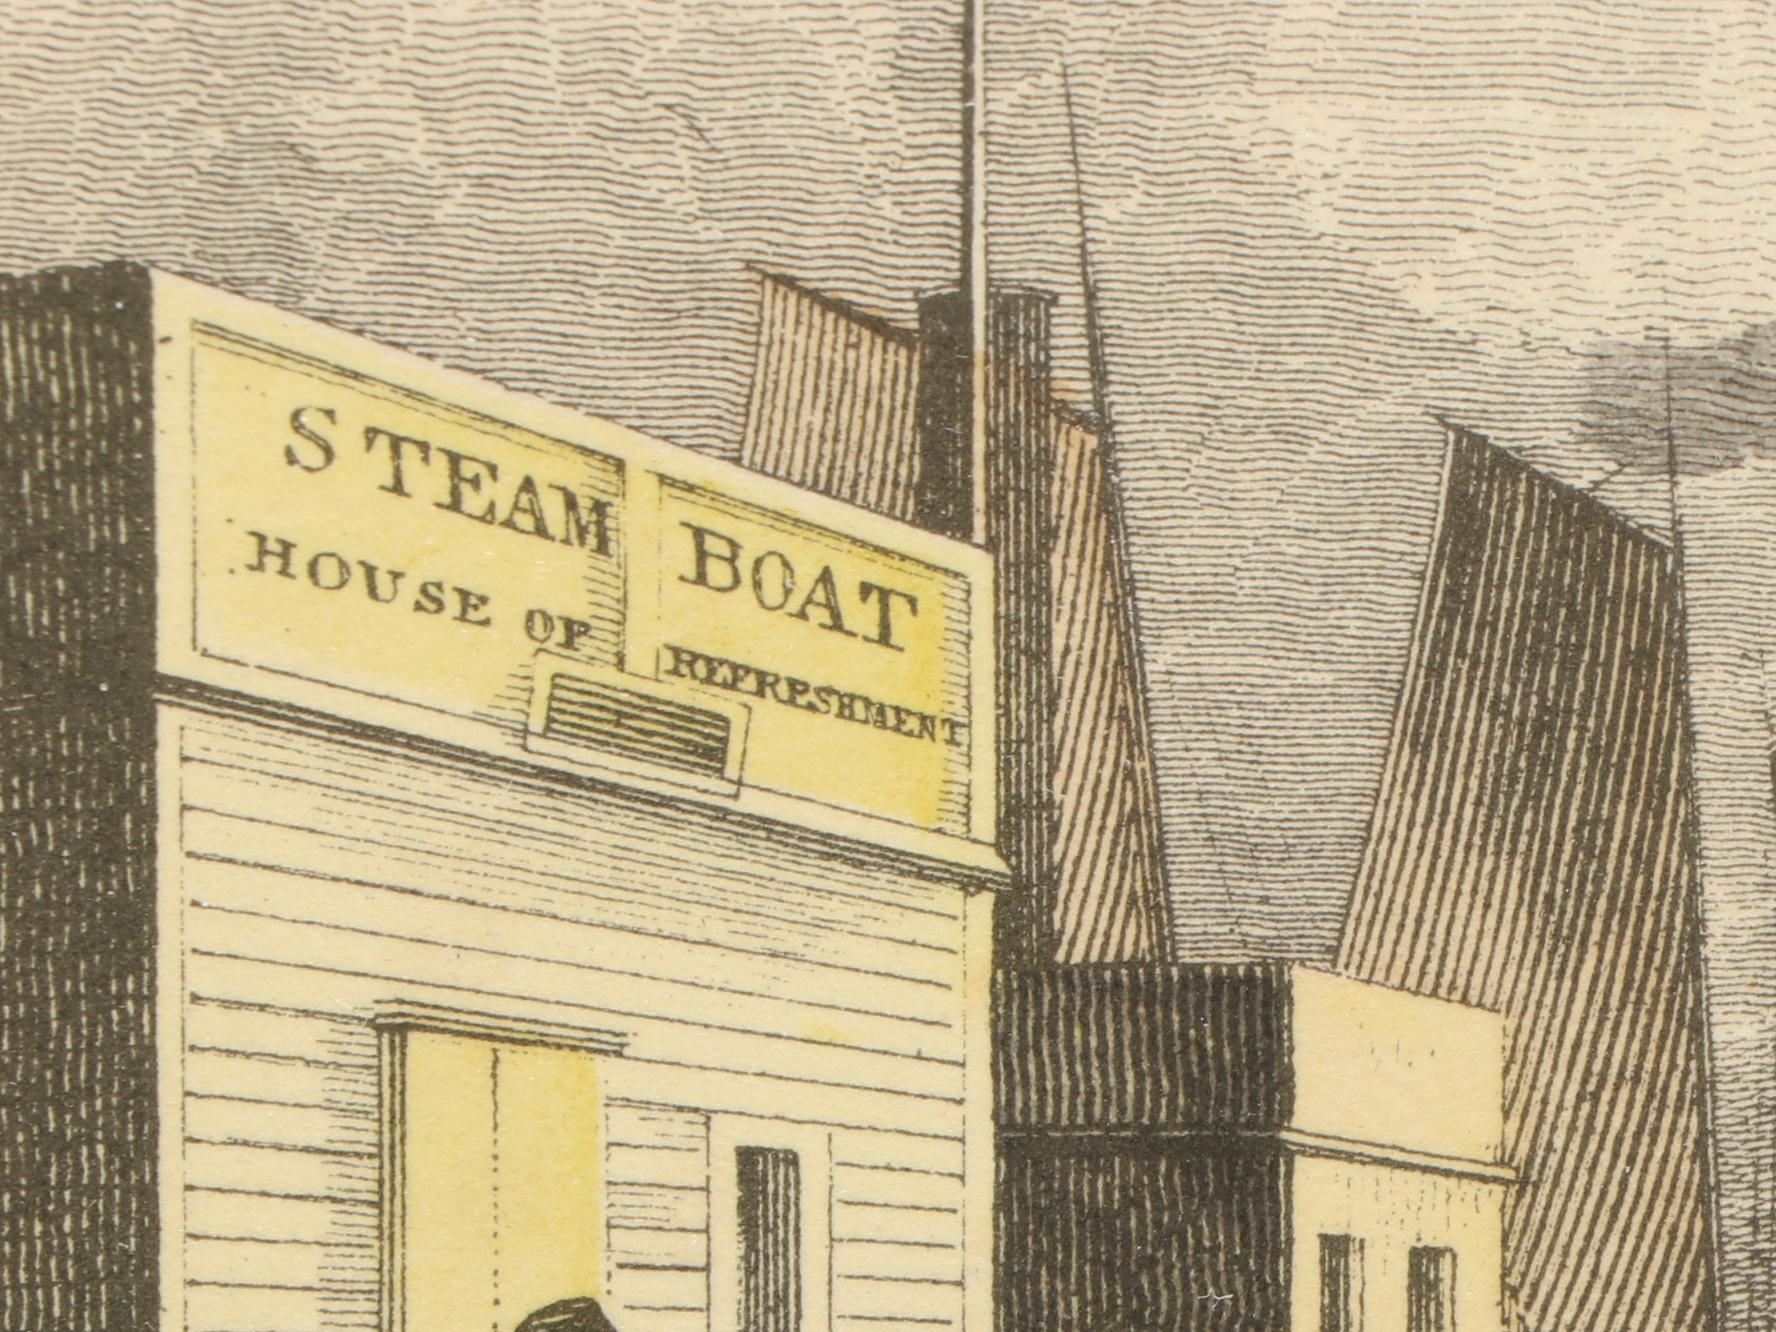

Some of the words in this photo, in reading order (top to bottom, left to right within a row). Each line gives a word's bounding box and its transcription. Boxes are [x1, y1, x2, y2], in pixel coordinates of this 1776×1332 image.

[245, 530, 492, 628] HOUSE
[662, 643, 968, 748] REFRESHMENT
[283, 404, 616, 560] STEAM
[677, 520, 918, 653] BOAT
